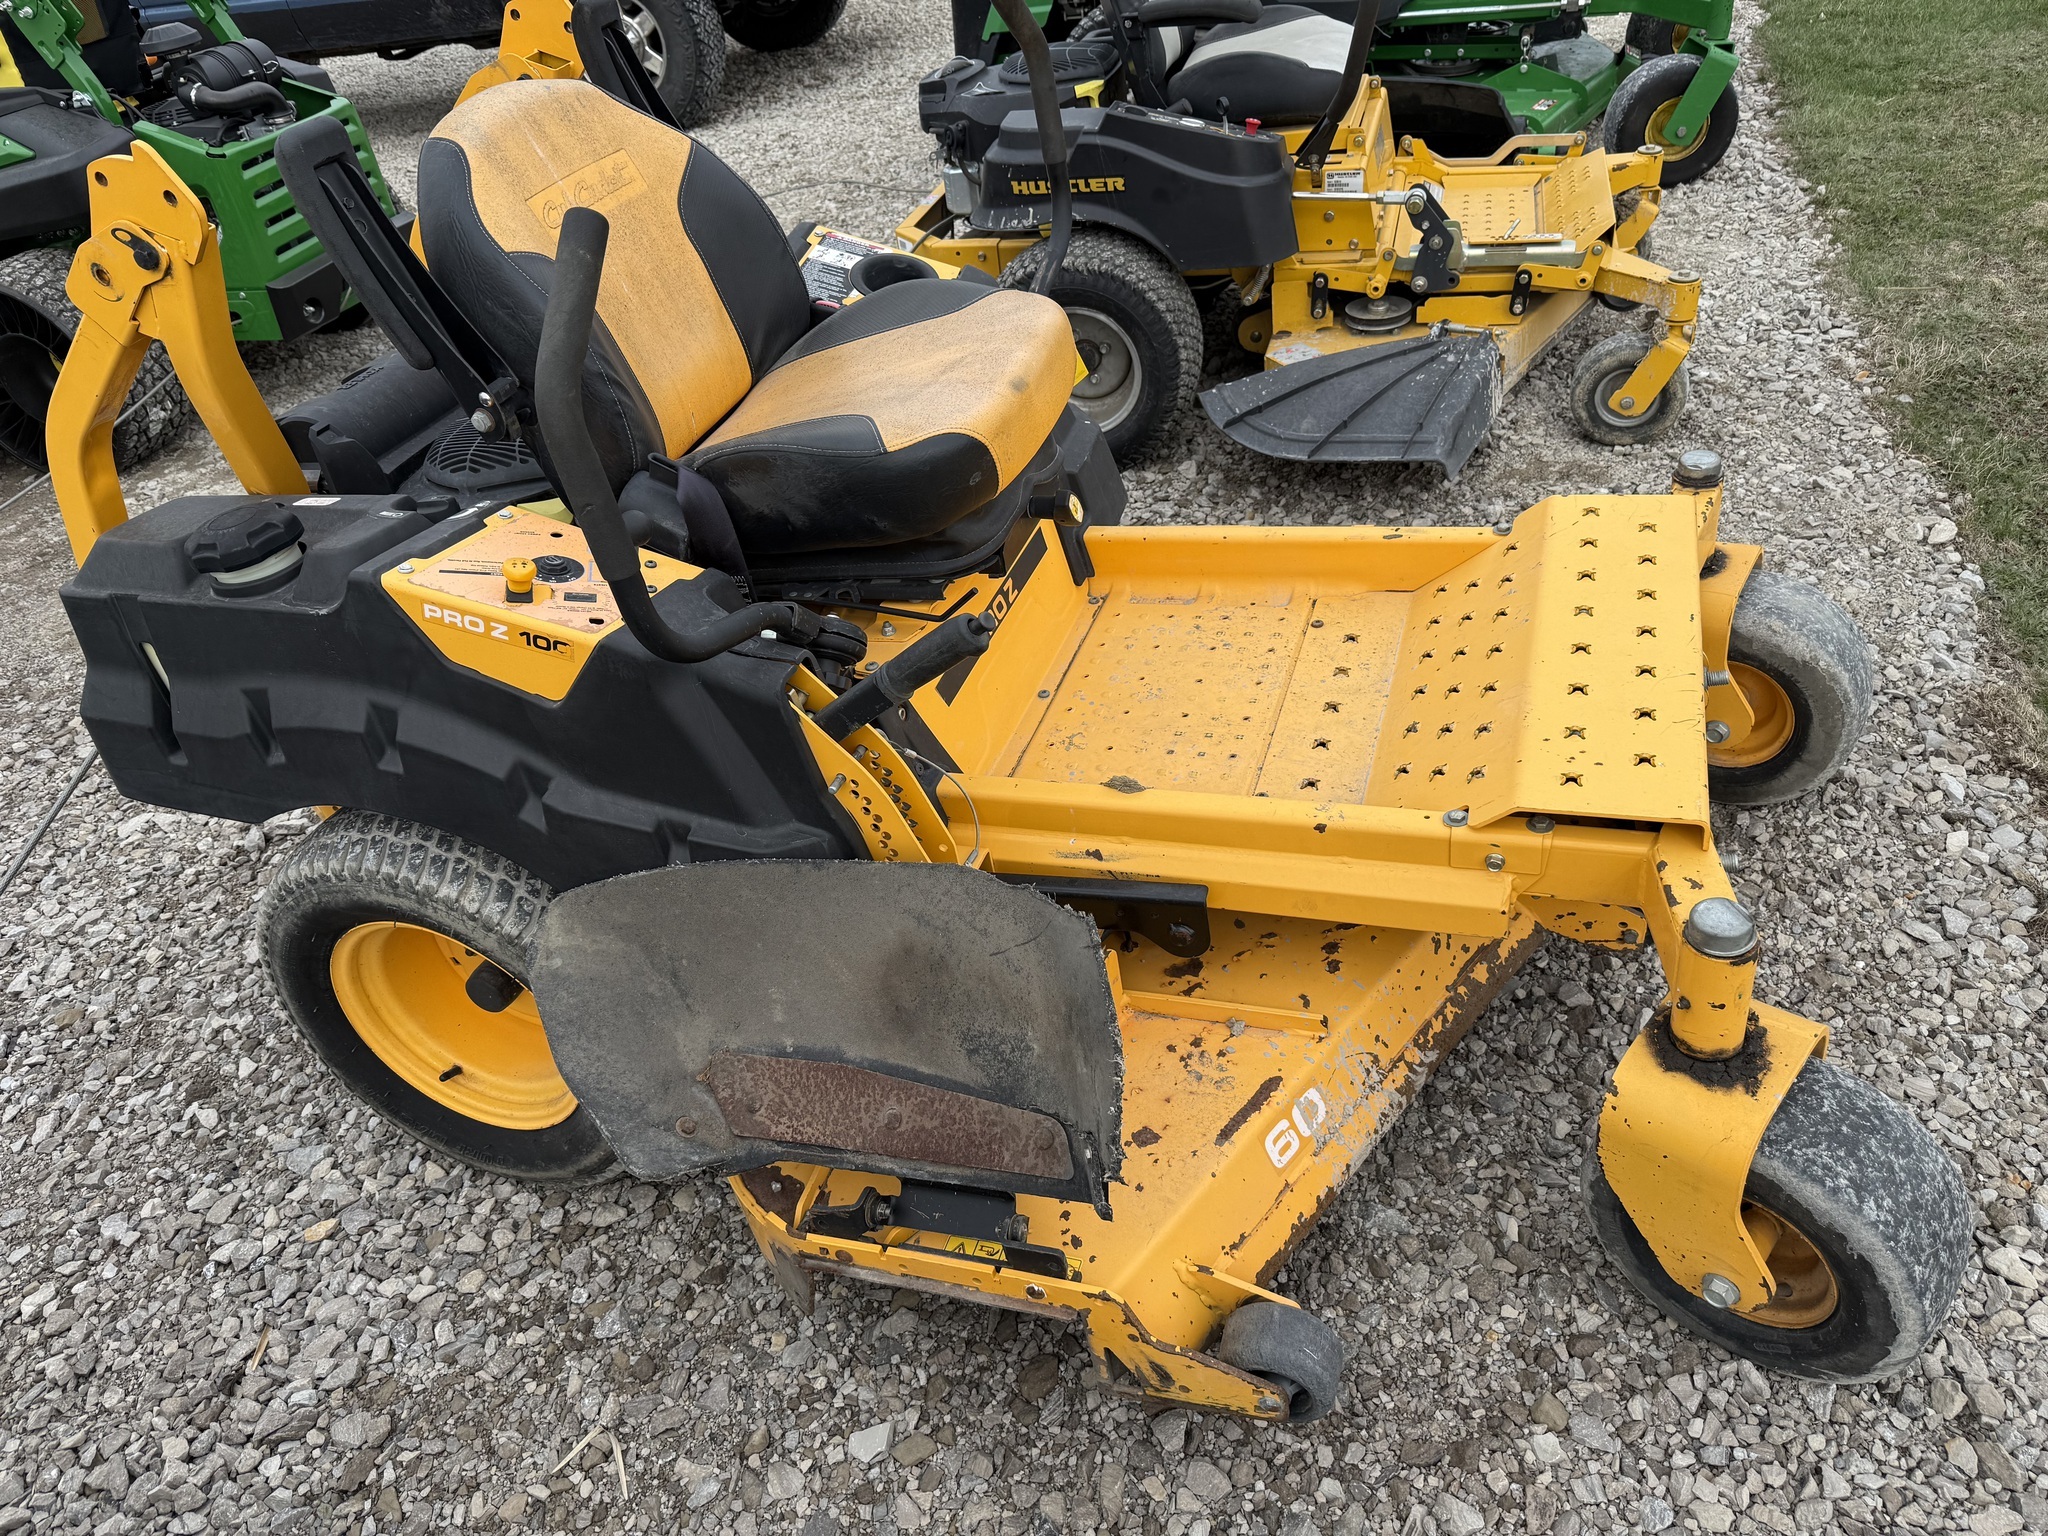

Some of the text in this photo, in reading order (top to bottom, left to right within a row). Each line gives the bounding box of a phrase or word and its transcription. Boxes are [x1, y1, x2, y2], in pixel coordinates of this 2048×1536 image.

[573, 161, 633, 208] Cadet
[1011, 177, 1126, 195] HUTLER
[423, 603, 485, 633] PRO
[490, 622, 509, 641] Z
[1265, 1088, 1327, 1168] 60
